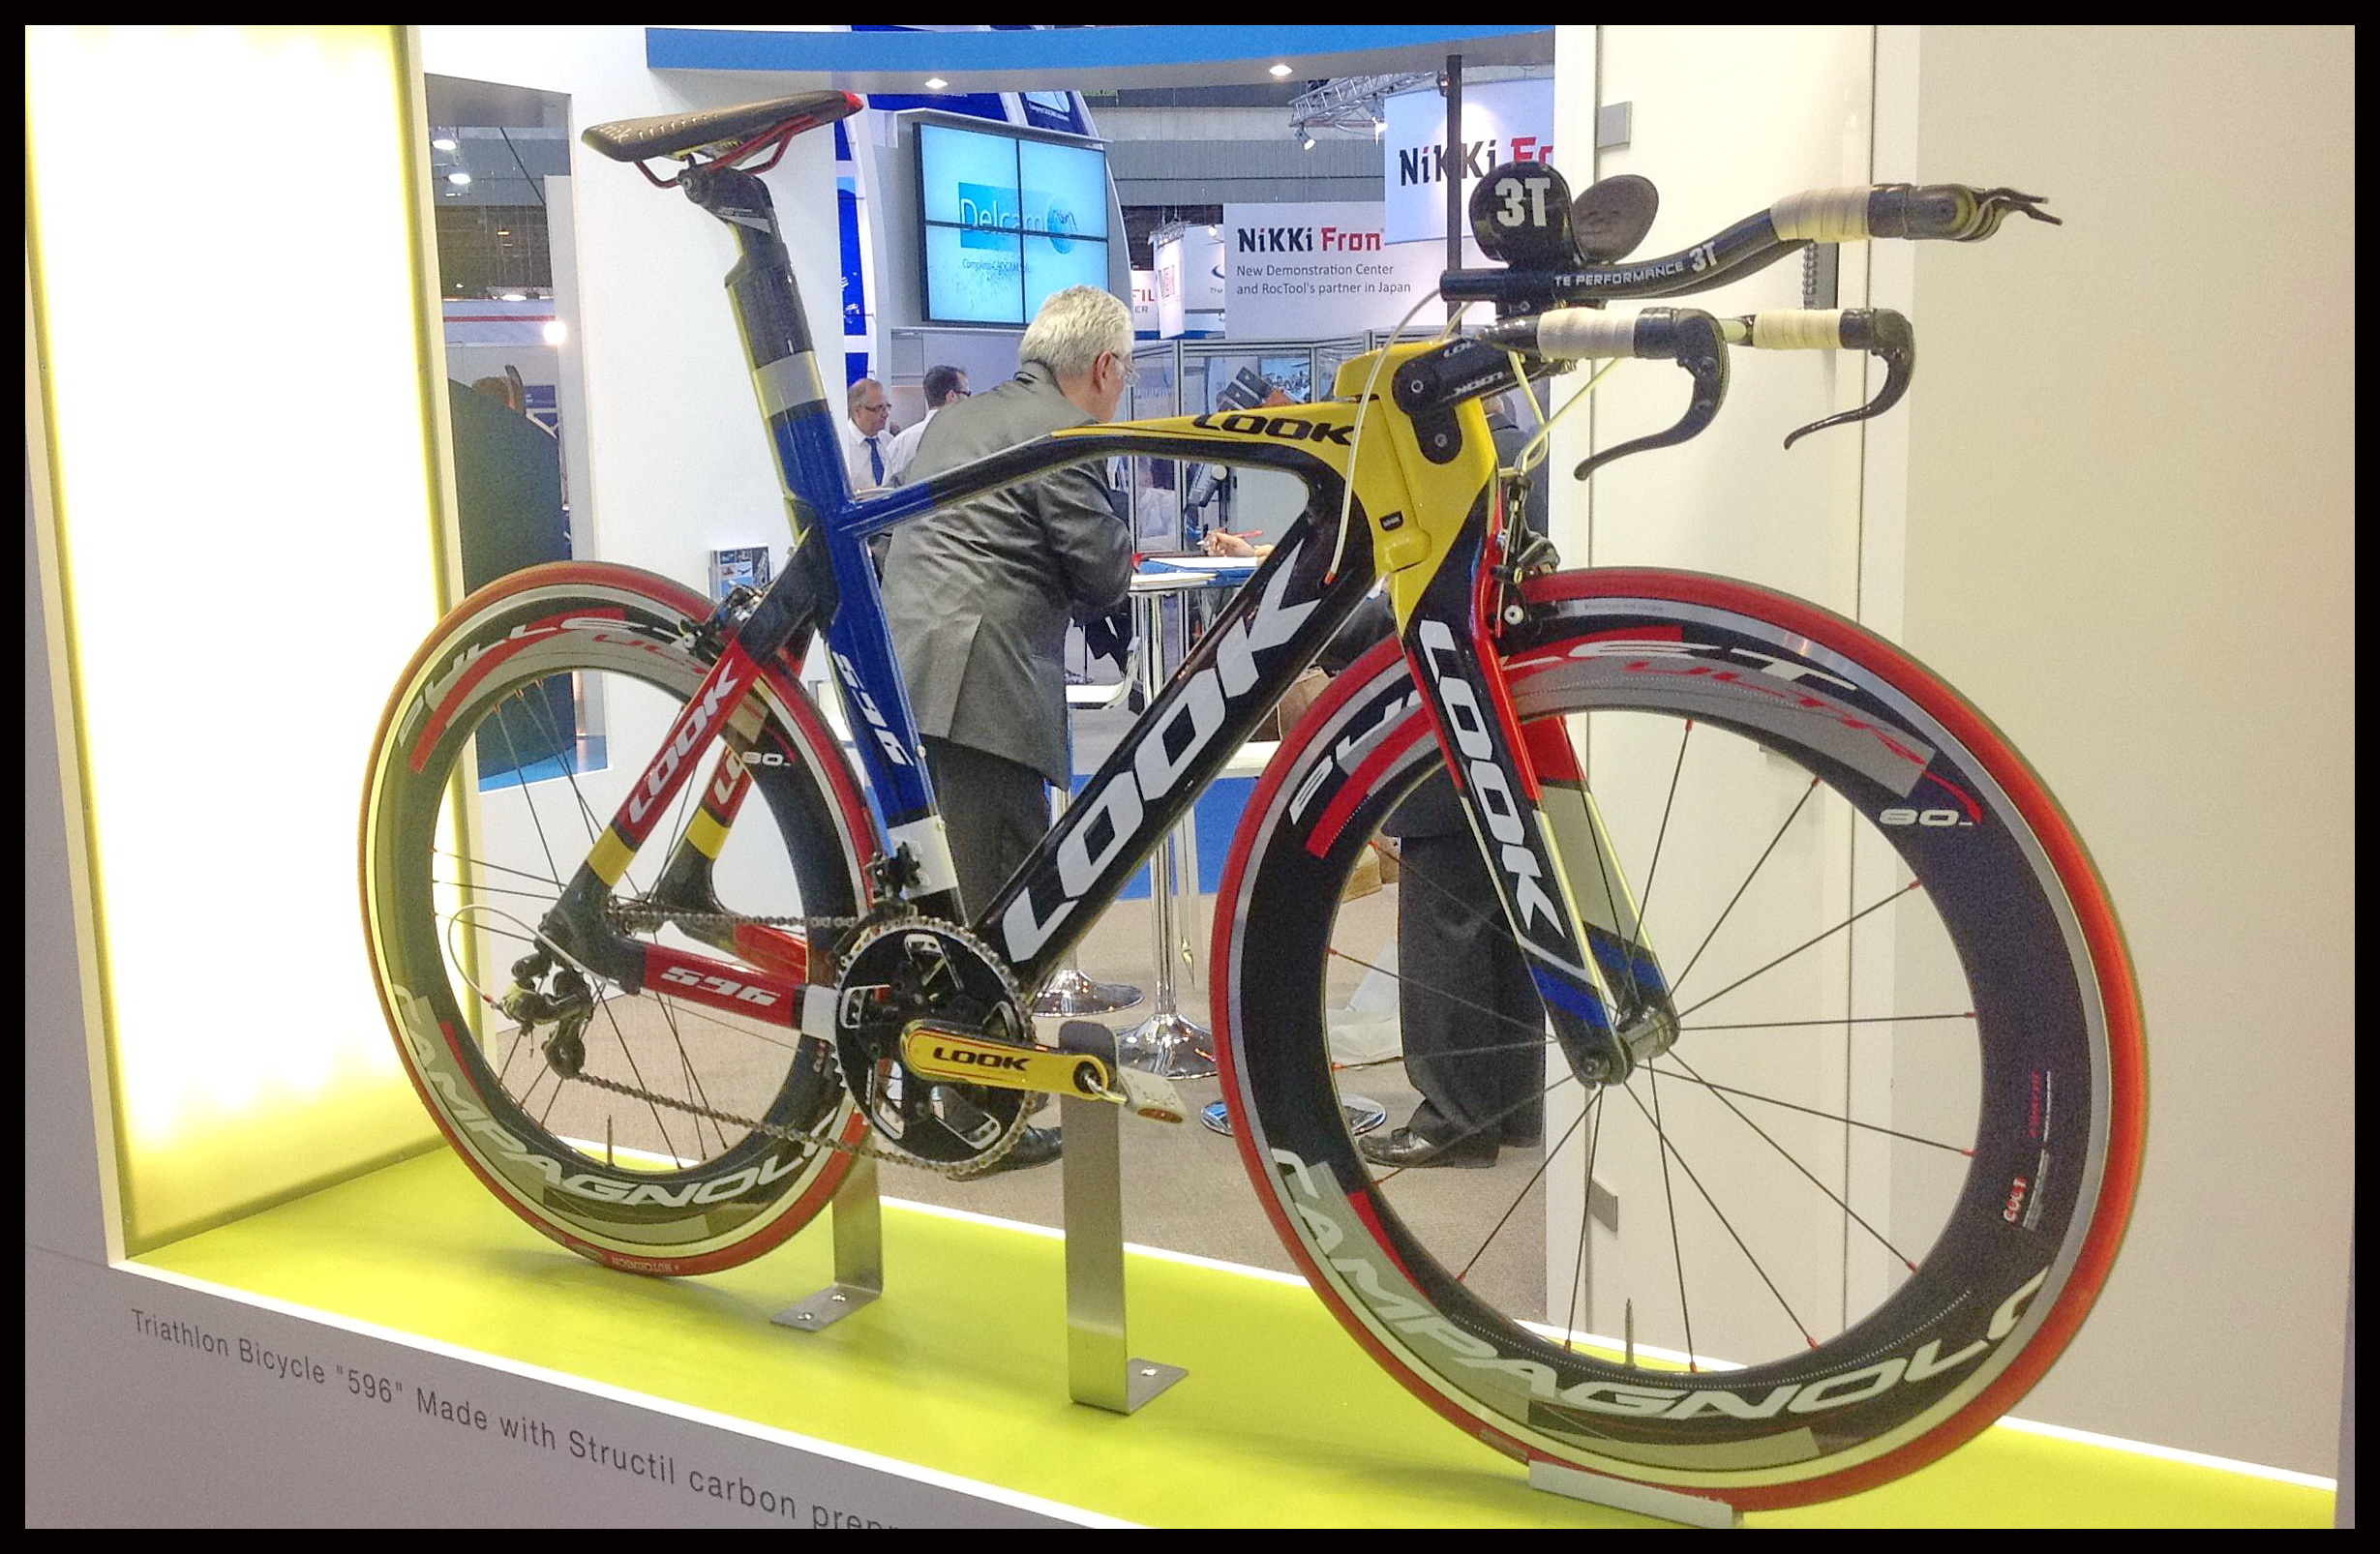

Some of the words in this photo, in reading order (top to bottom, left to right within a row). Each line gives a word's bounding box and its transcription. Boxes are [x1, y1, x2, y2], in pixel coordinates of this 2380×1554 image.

[960, 197, 1045, 234] Delcam
[1495, 178, 1552, 227] 3T
[1237, 227, 1313, 253] NiKKi
[1321, 226, 1381, 252] Fron
[1689, 241, 1718, 272] 3T
[1236, 265, 1263, 277] New
[1266, 263, 1352, 277] Demonstration
[1355, 263, 1394, 276] Center
[1576, 260, 1684, 286] PERFORMANCE
[1236, 284, 1258, 295] and
[1262, 283, 1315, 295] RocTool's
[1318, 283, 1361, 296] partner
[1365, 282, 1375, 293] in
[1378, 282, 1411, 296] Japan
[1191, 413, 1364, 447] LOOK
[831, 651, 915, 766] 596
[629, 658, 739, 823] LOOK
[1002, 538, 1323, 964] LOOK
[1419, 619, 1566, 939] LOOK
[661, 966, 781, 1007] 596
[932, 1046, 1032, 1072] LOOK
[132, 1308, 229, 1357] Triathlon
[238, 1338, 325, 1385] Bicycle
[336, 1364, 403, 1404] "596"
[416, 1388, 488, 1431] Made
[499, 1417, 557, 1450] with
[568, 1429, 676, 1485] Structil
[689, 1470, 797, 1520] carbon
